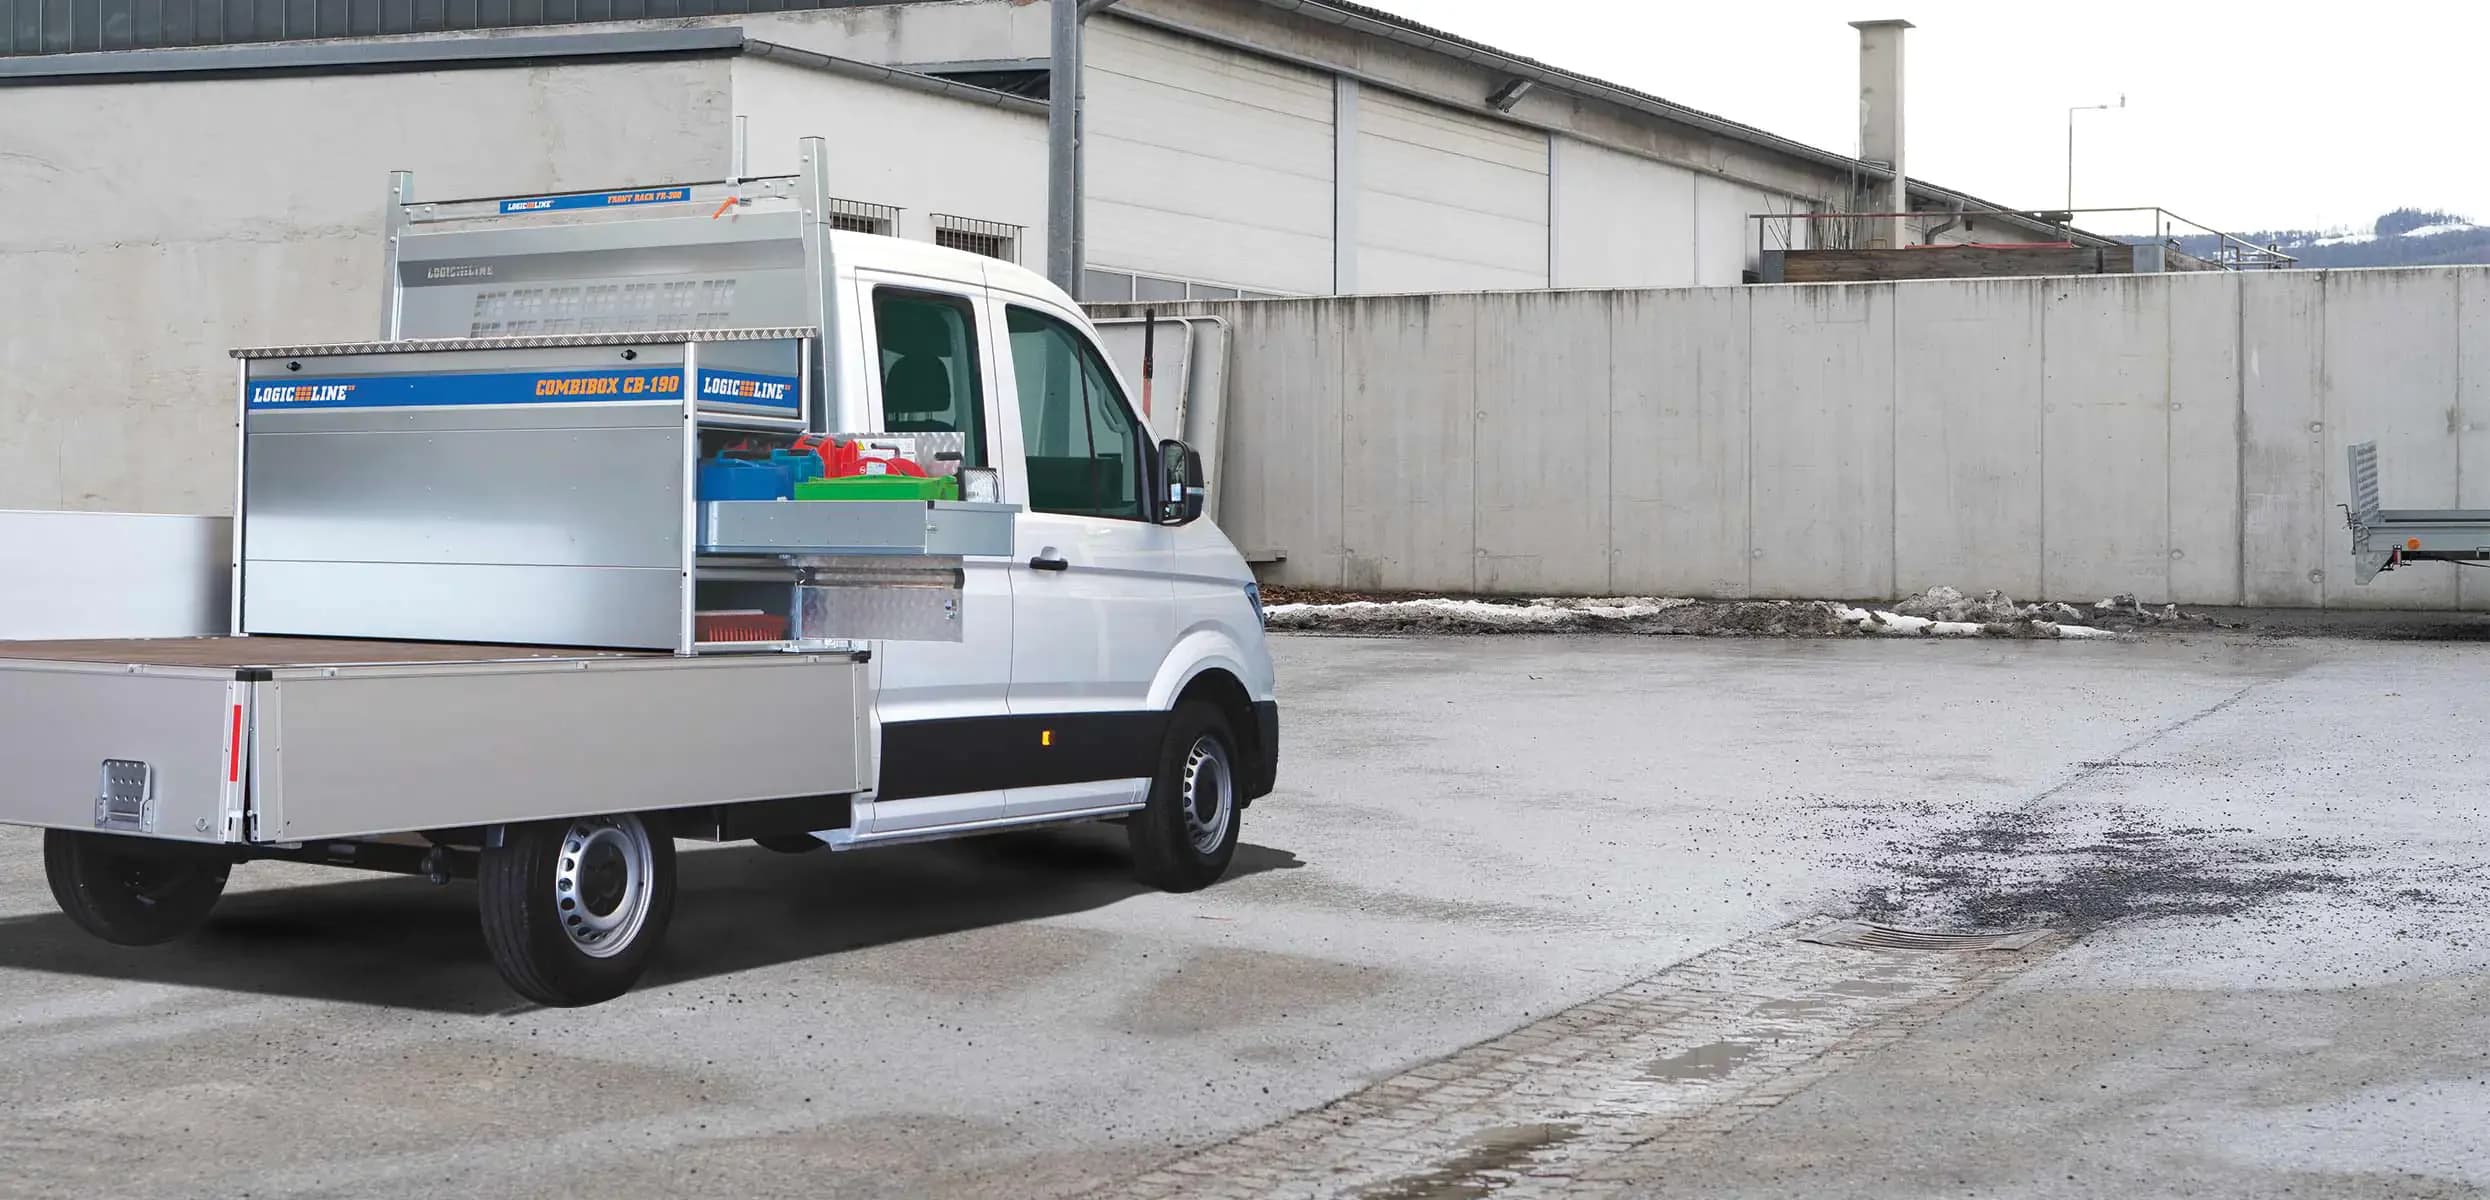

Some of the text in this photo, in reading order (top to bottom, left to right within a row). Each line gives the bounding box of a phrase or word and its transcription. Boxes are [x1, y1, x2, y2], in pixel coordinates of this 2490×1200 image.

[253, 384, 348, 403] LOGIC LINE
[535, 375, 680, 396] COMBIBOX CB-190
[703, 376, 785, 400] LOGIC LINE
